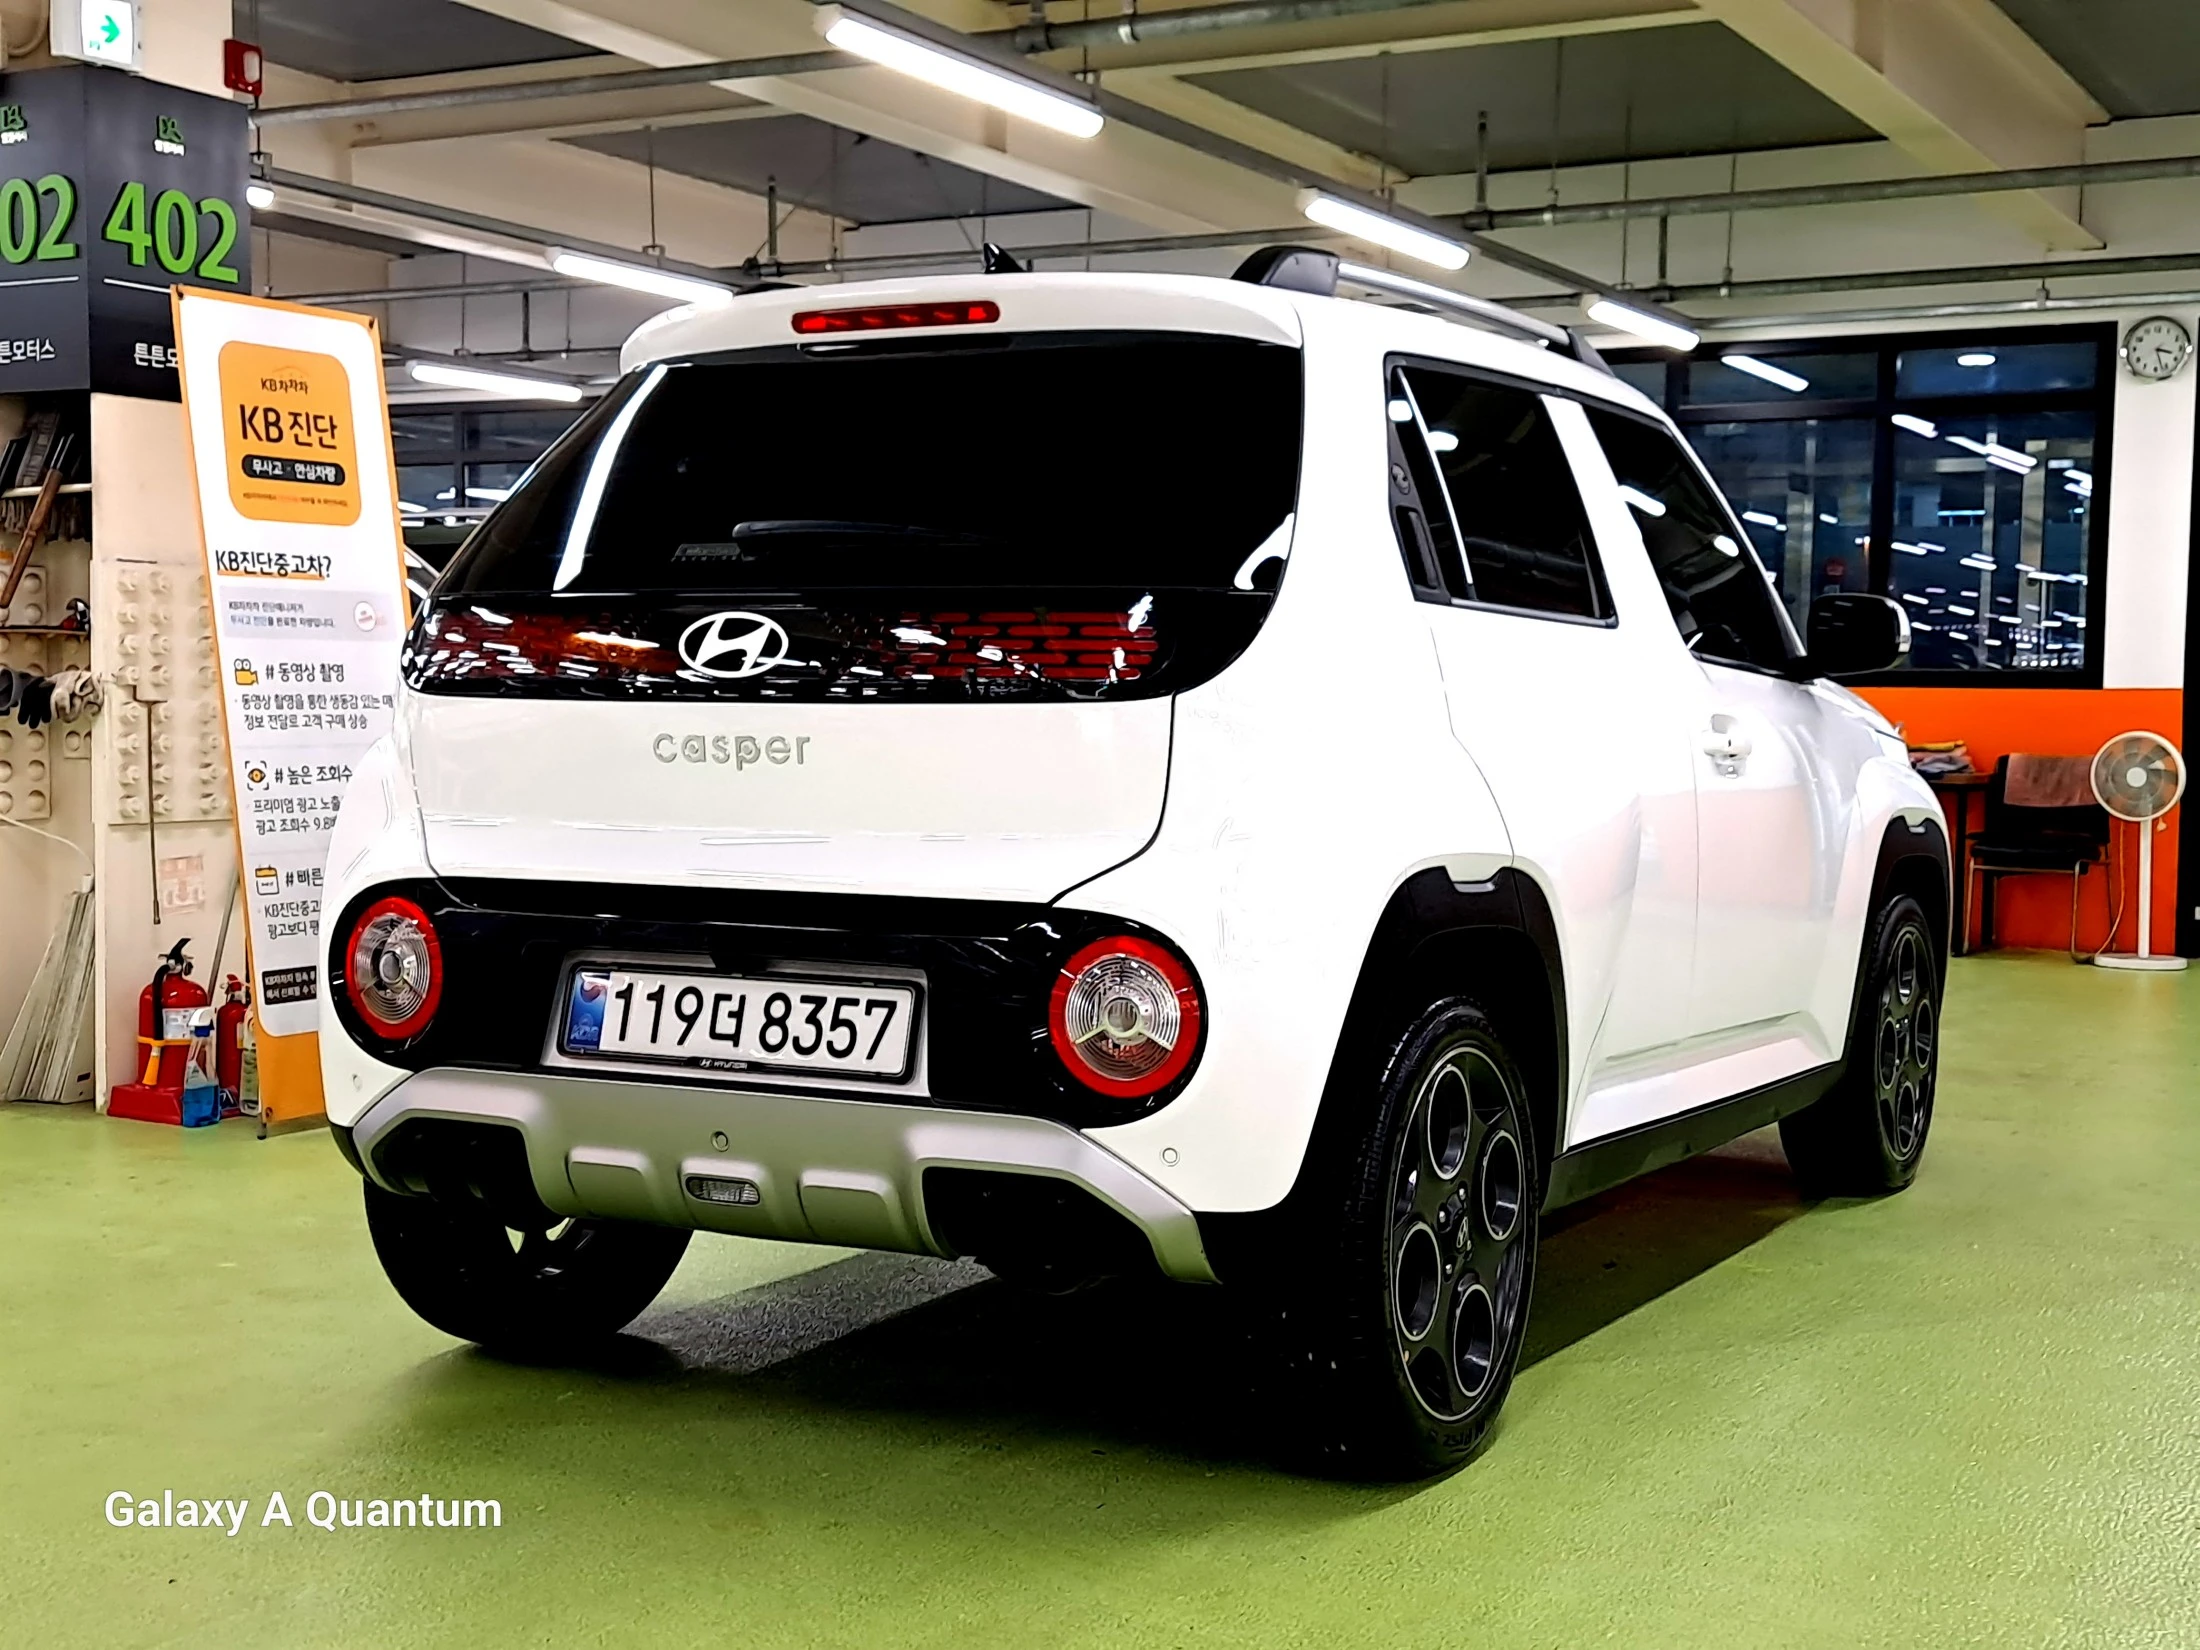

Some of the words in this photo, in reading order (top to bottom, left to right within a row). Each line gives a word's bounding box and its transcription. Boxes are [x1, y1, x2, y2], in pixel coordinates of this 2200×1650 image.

[103, 181, 239, 284] 402
[252, 458, 284, 476] 무사고
[215, 549, 332, 579] KB진단중고차?
[278, 662, 316, 683] 동영상
[319, 662, 345, 683] 촬영
[241, 693, 271, 711] 동영상
[274, 693, 304, 711] 촬영을
[330, 694, 359, 711] 생동감
[360, 694, 381, 710] 있는
[244, 714, 265, 731] 정보
[302, 714, 323, 730] 고객
[325, 713, 346, 730] 구매
[348, 713, 368, 730] 상승
[652, 732, 811, 772] casper
[287, 764, 313, 786] 높은
[316, 764, 353, 784] 조회수
[253, 797, 295, 814] 프리미엄
[296, 797, 318, 814] 광고
[320, 795, 341, 812] 노출
[255, 818, 277, 836] 광고
[279, 817, 311, 833] 조회수
[614, 981, 747, 1049] 119더
[758, 991, 898, 1061] 8357
